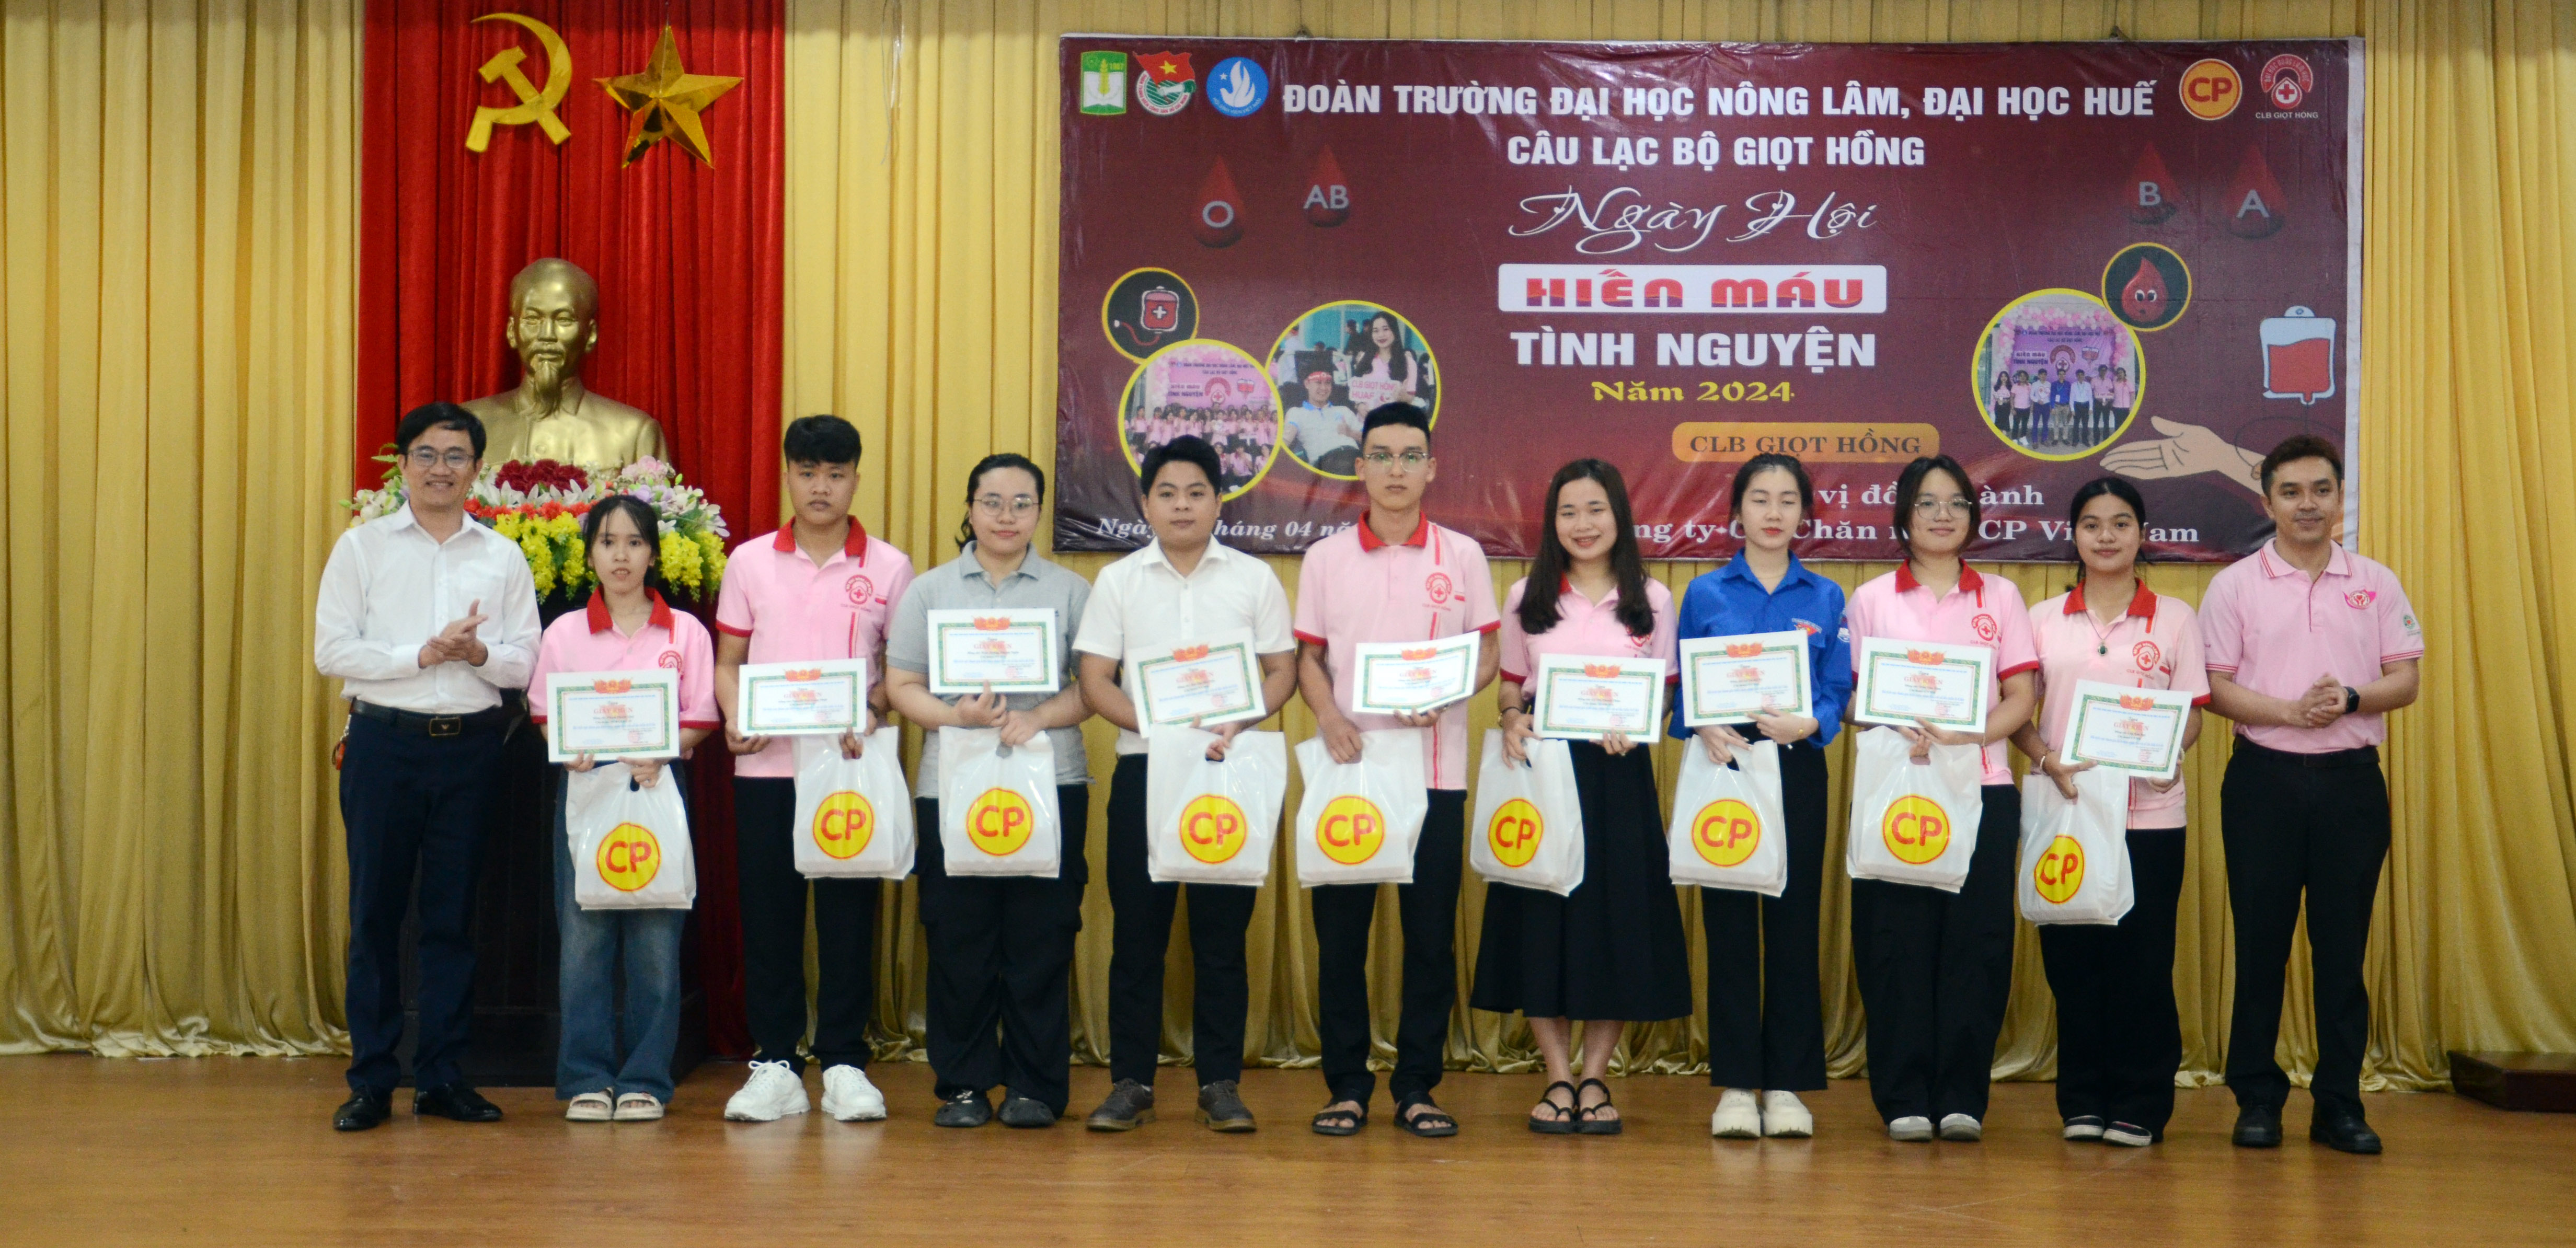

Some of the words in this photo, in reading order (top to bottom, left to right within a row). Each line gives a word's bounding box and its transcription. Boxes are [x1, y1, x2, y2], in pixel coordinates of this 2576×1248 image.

[1283, 80, 1379, 113] ĐOÀN
[1394, 84, 1536, 115] TRƯỜNG
[1550, 87, 1608, 120] ĐẠI
[1623, 87, 1694, 122] HỌC
[1708, 81, 1808, 115] NÔNG
[1823, 80, 1910, 119] LÂM,
[1923, 87, 1983, 121] ĐẠI
[1998, 87, 2069, 121] HỌC
[2085, 80, 2158, 115] HUẾ
[2187, 77, 2232, 97] CP
[1508, 130, 1579, 165] CÂU
[1592, 136, 1659, 171] LẠC
[1673, 131, 1719, 171] BỘ
[1733, 136, 1813, 171] GIỌT
[1826, 130, 1924, 166] HỒNG
[1304, 185, 1350, 209] AB
[2139, 182, 2161, 205] B
[2236, 190, 2270, 218] A
[1203, 201, 1234, 228] O
[1508, 186, 1727, 255] Ngày
[1726, 189, 1878, 242] Hội
[1510, 325, 1635, 366] TÌNH
[1657, 326, 1876, 373] NGUYỆN
[1591, 381, 1684, 401] Năm
[1697, 381, 1795, 401] 2024
[1690, 436, 1745, 453] CLB
[1756, 436, 1827, 456] GIỌT
[1836, 428, 1922, 453] HỒNG
[1818, 484, 1849, 509] vị
[1979, 484, 2044, 505] ành
[1214, 520, 1276, 540] háng
[1285, 521, 1313, 537] 04
[1684, 519, 1716, 543] ty
[1978, 519, 2027, 540] CP
[2144, 523, 2200, 542] am
[821, 810, 866, 841] CP
[977, 805, 1023, 837] CP
[1188, 812, 1237, 846] CP
[1324, 813, 1376, 848] CP
[1494, 815, 1536, 850] CP
[1700, 815, 1753, 850] CP
[1890, 812, 1942, 847] CP
[605, 841, 651, 873] CP
[2040, 852, 2078, 885] CP
